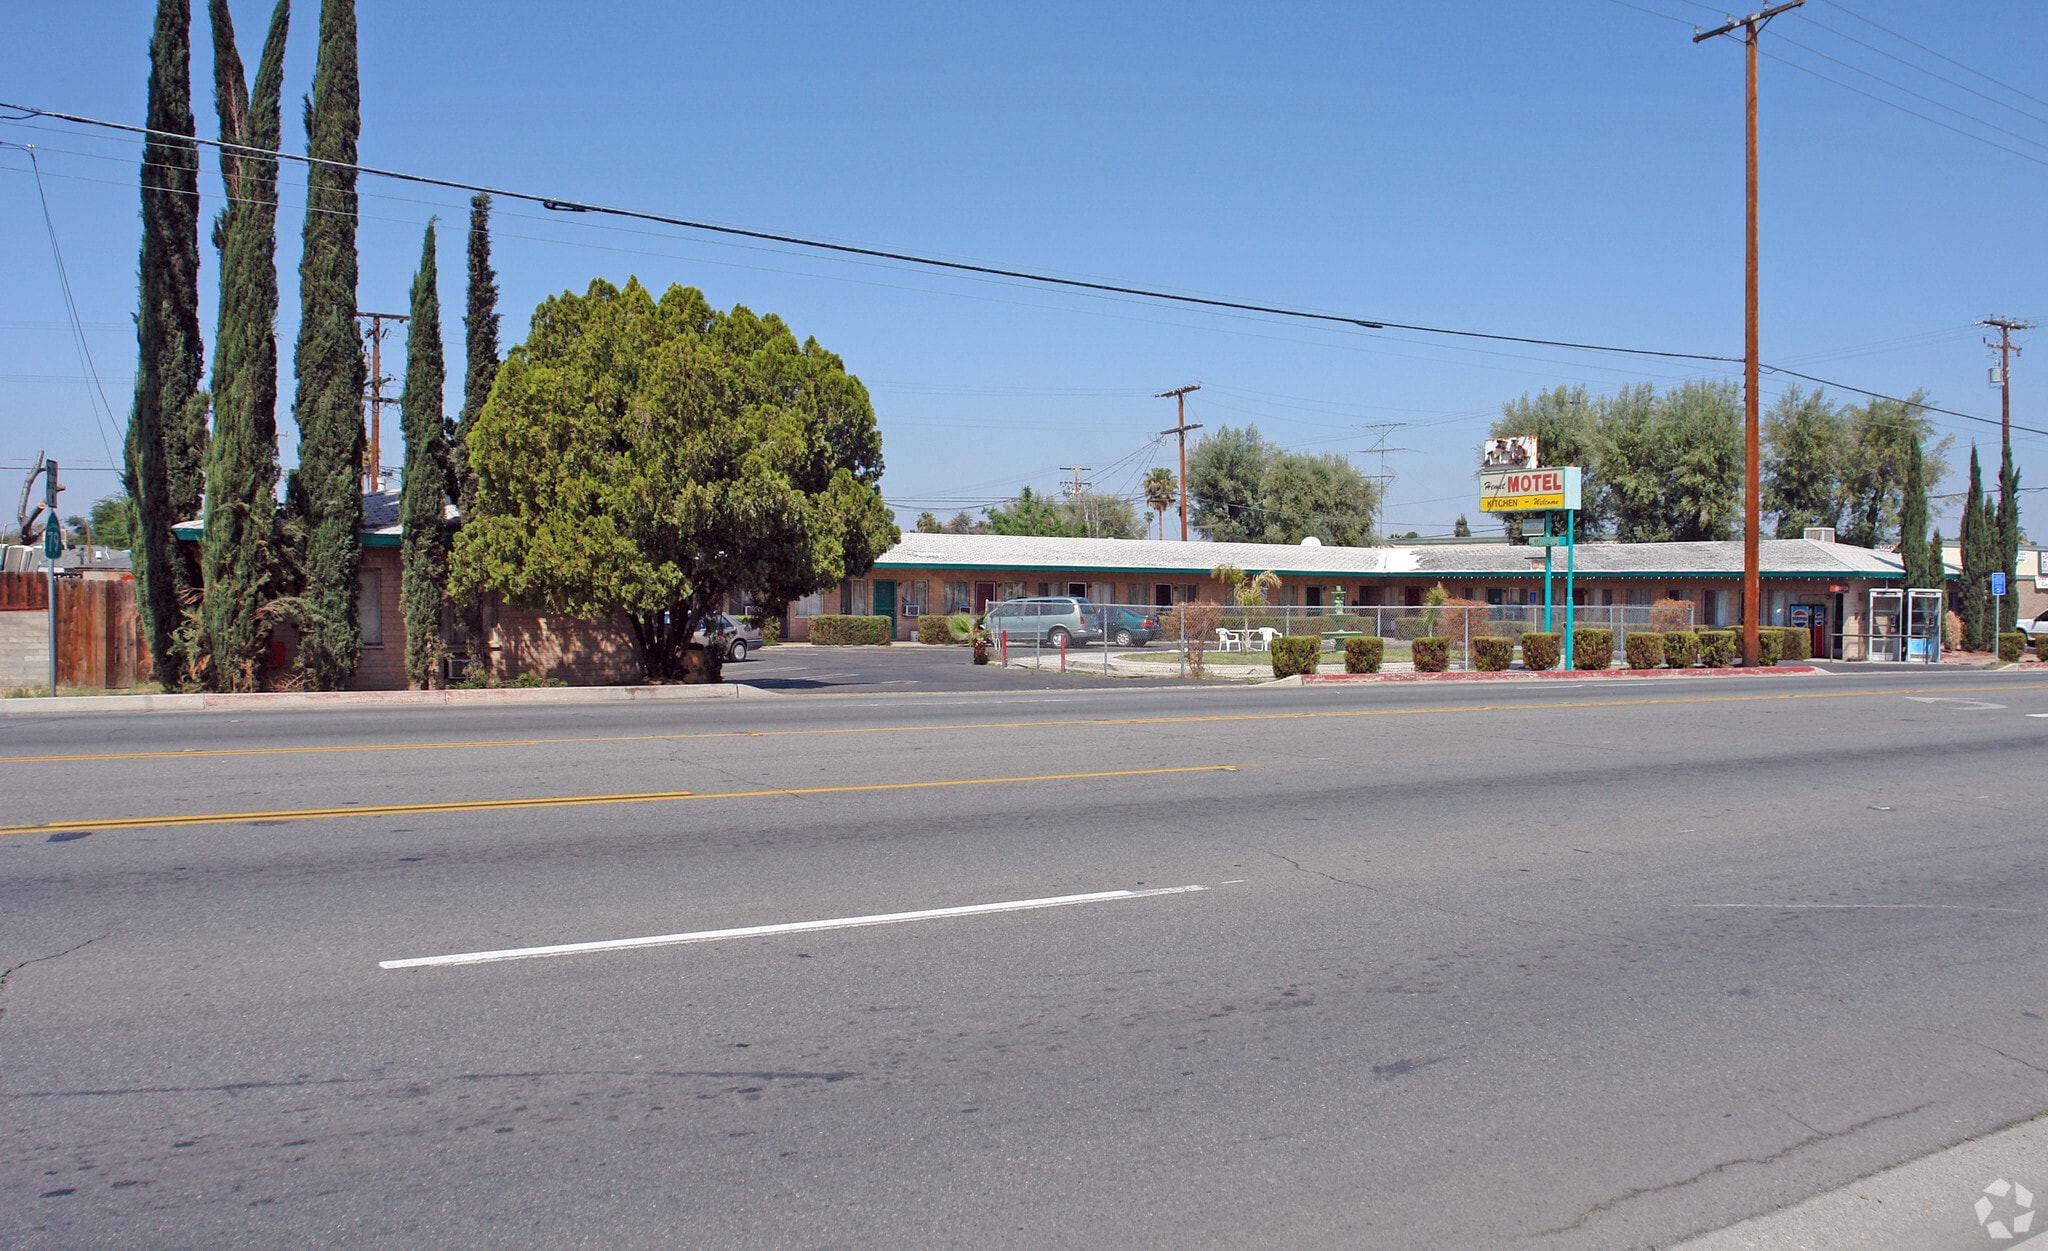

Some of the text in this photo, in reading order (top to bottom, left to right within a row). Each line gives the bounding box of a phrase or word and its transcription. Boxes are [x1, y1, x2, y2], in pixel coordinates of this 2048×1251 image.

[1508, 473, 1562, 492] MOTEL
[1487, 499, 1518, 508] KITCHEN
[48, 531, 59, 552] 79
